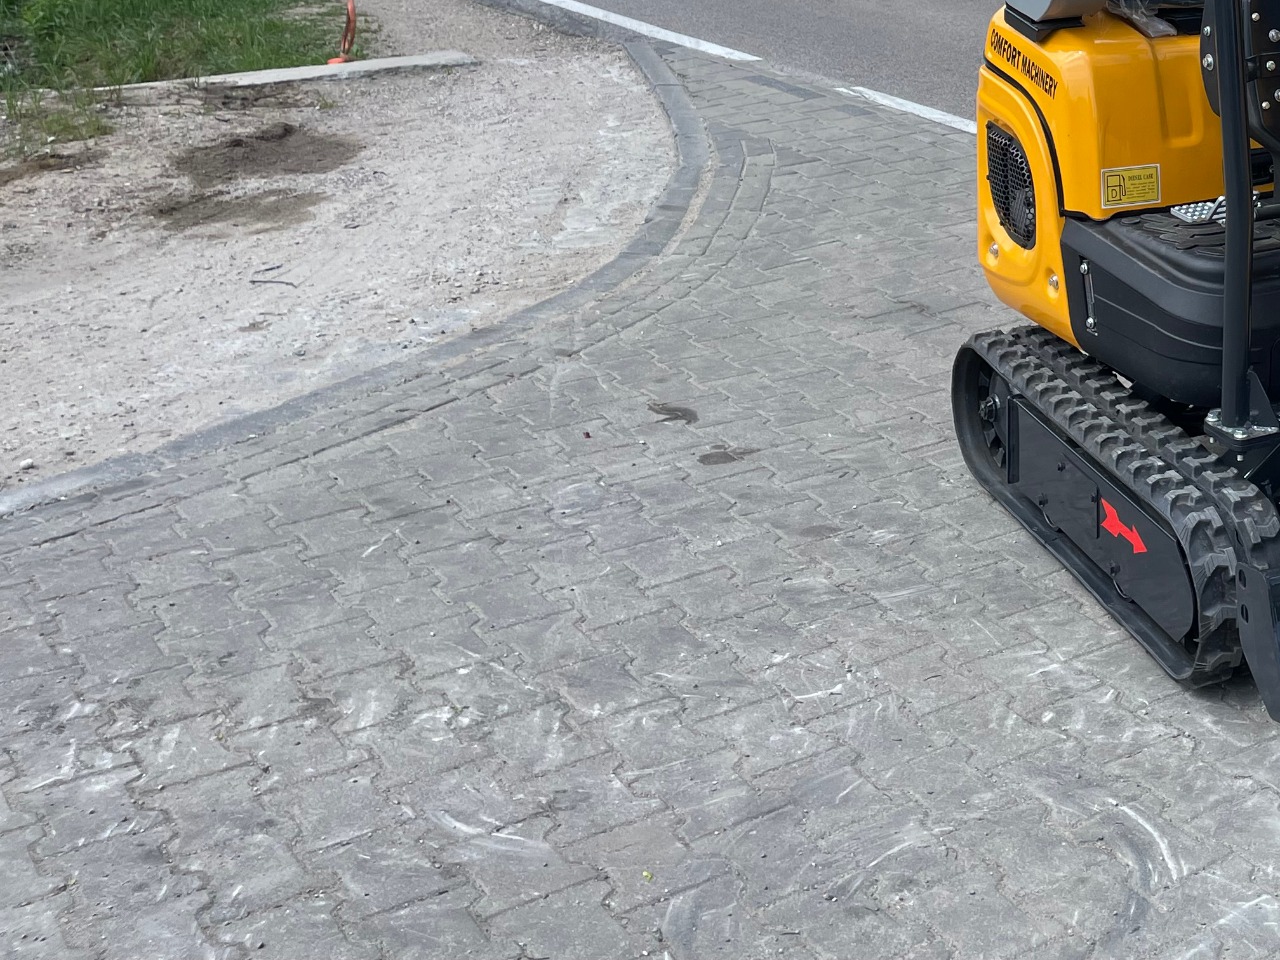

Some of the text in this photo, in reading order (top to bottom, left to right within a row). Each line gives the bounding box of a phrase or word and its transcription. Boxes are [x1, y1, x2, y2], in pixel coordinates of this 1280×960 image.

[990, 28, 1059, 100] COMFORT MACHINERY
[1111, 189, 1118, 199] D
